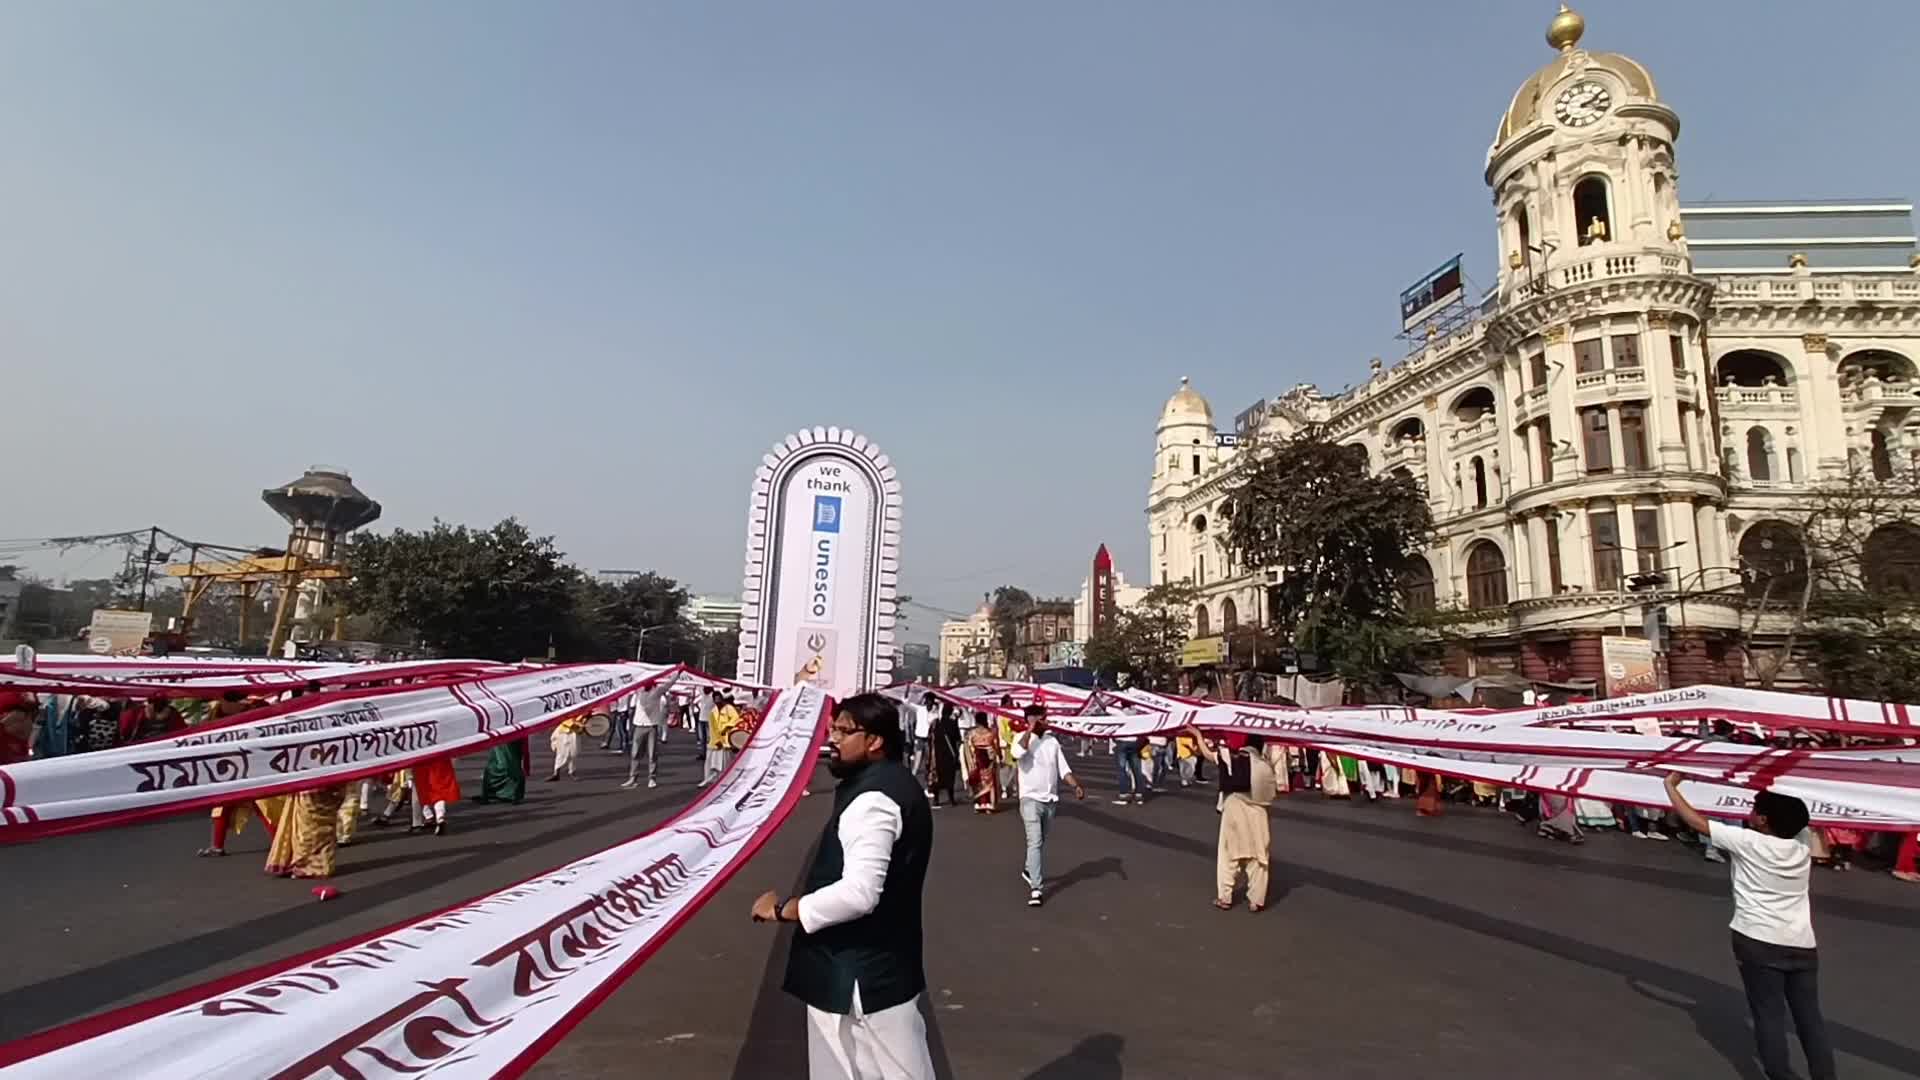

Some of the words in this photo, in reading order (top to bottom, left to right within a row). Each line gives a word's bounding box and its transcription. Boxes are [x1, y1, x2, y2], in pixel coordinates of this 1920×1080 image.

[807, 478, 852, 493] thank
[819, 466, 842, 478] we
[812, 539, 831, 617] unesco
[129, 748, 253, 793] মমতা
